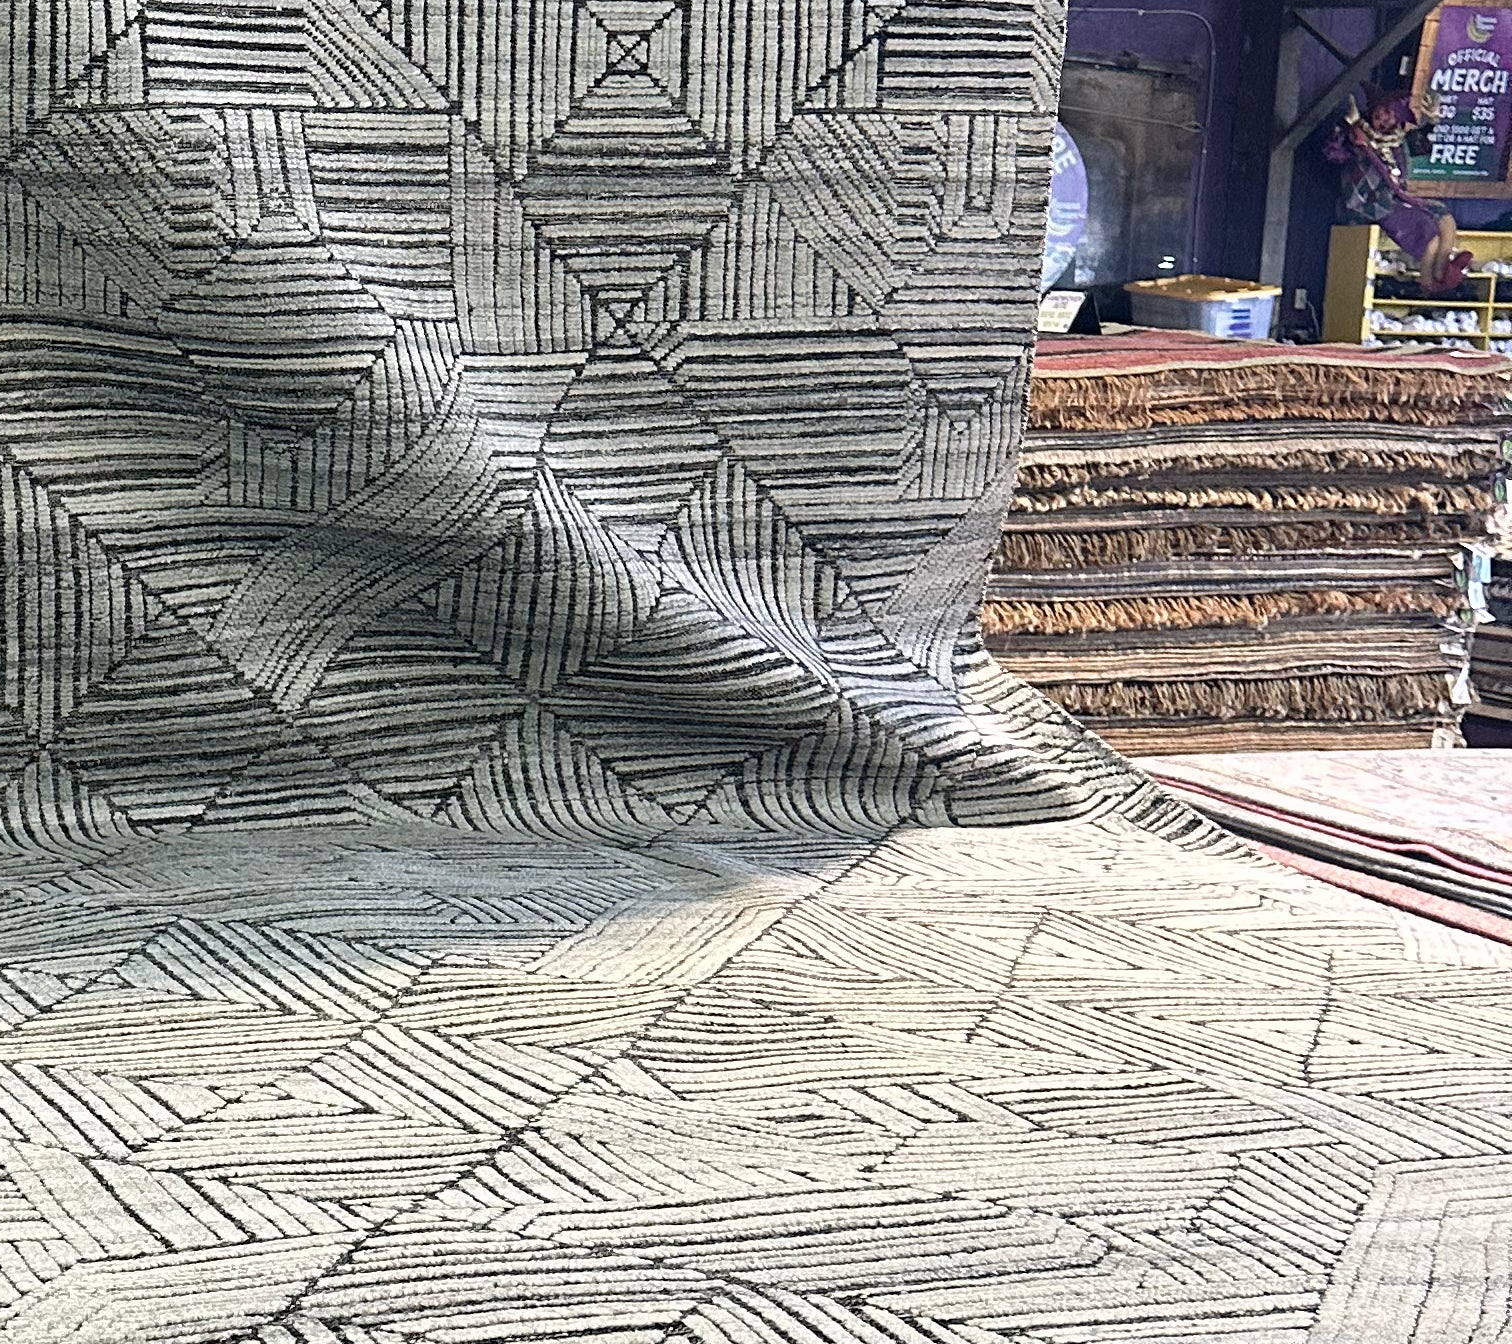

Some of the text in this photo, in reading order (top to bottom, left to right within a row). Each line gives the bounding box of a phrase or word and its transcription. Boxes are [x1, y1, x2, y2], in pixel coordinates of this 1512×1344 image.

[1448, 47, 1501, 68] OFFICIAL
[1430, 68, 1510, 94] MERCH
[1430, 143, 1481, 166] FREE
